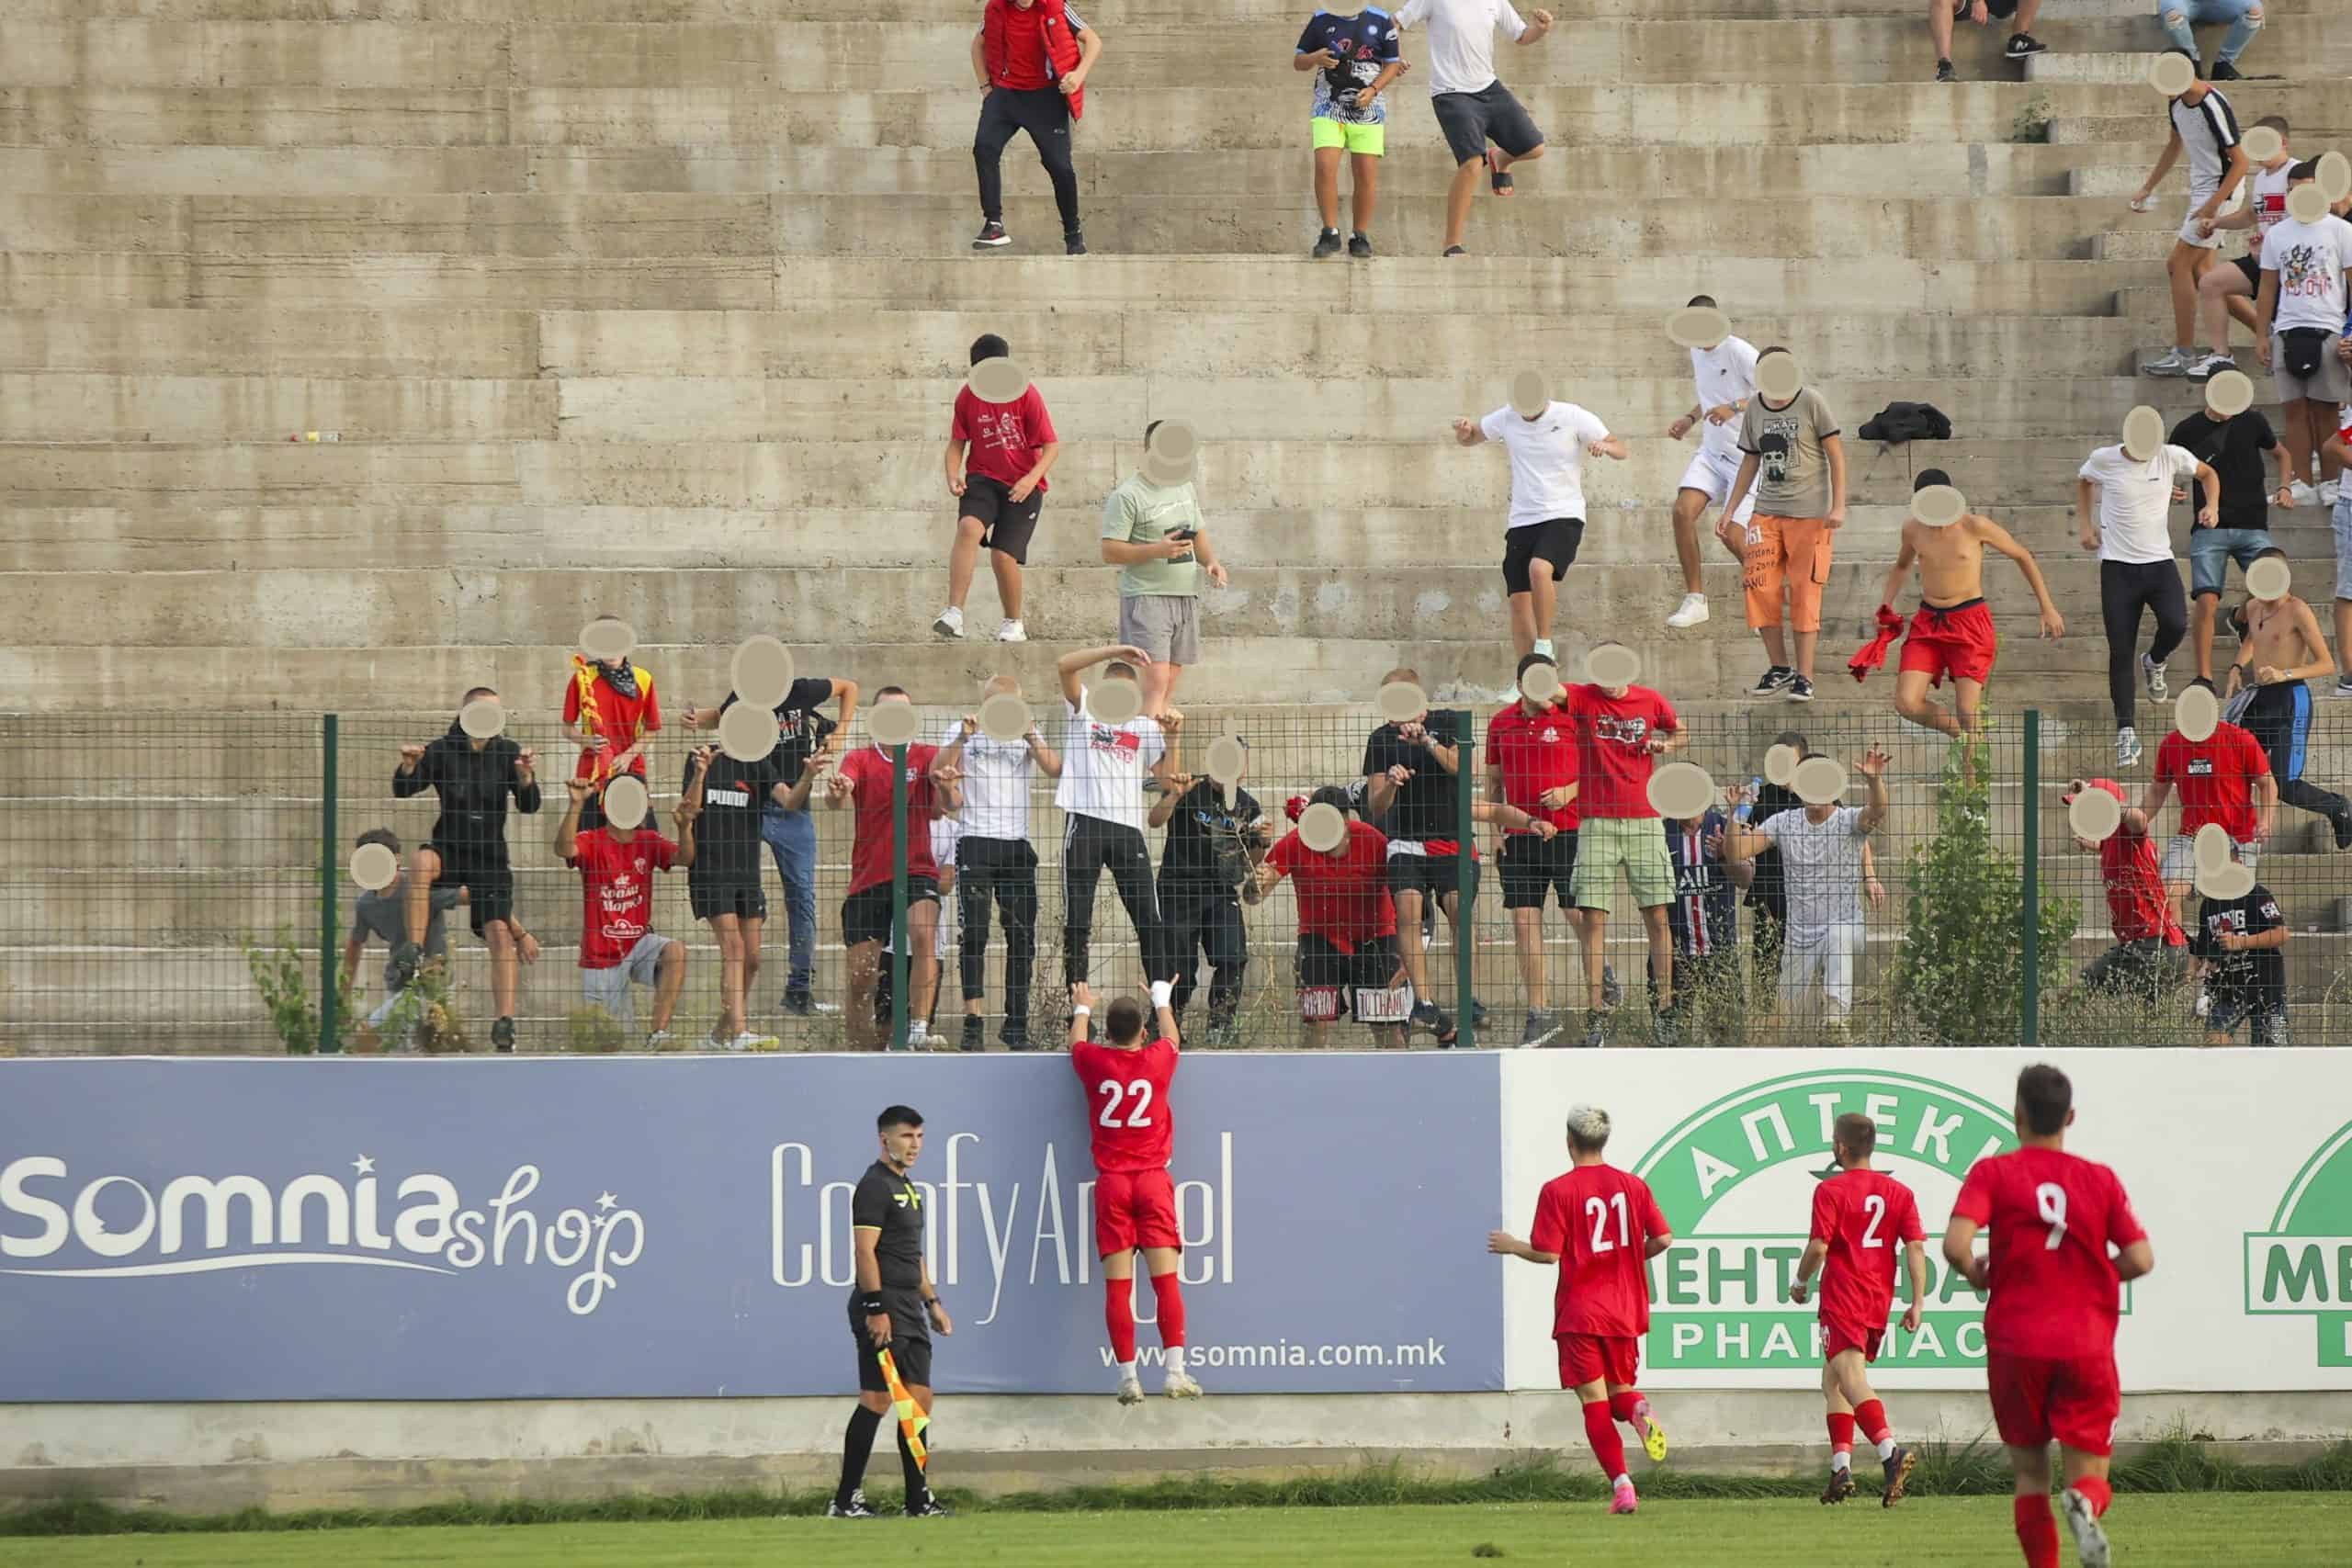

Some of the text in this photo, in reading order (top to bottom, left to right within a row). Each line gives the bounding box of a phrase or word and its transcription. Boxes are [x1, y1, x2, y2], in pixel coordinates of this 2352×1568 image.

[1099, 1078, 1153, 1128] 22
[1585, 1191, 1629, 1254] 21
[1861, 1194, 1885, 1248] 2
[2035, 1181, 2067, 1250] 9
[1672, 1321, 1988, 1359] PHAAC
